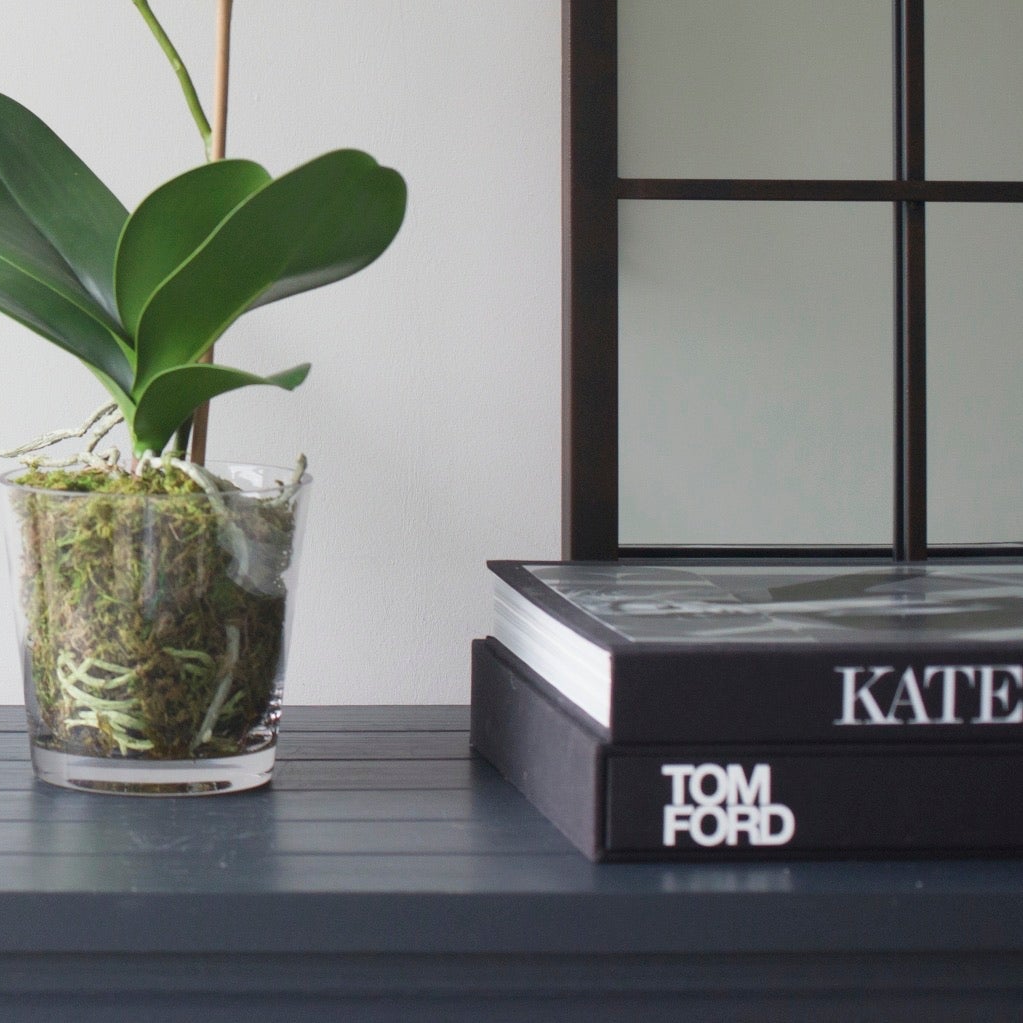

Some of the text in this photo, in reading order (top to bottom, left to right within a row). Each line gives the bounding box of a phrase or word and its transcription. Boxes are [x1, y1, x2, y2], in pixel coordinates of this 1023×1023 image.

[833, 665, 1023, 725] KATE
[661, 763, 772, 806] TOM
[662, 805, 796, 846] FORD
